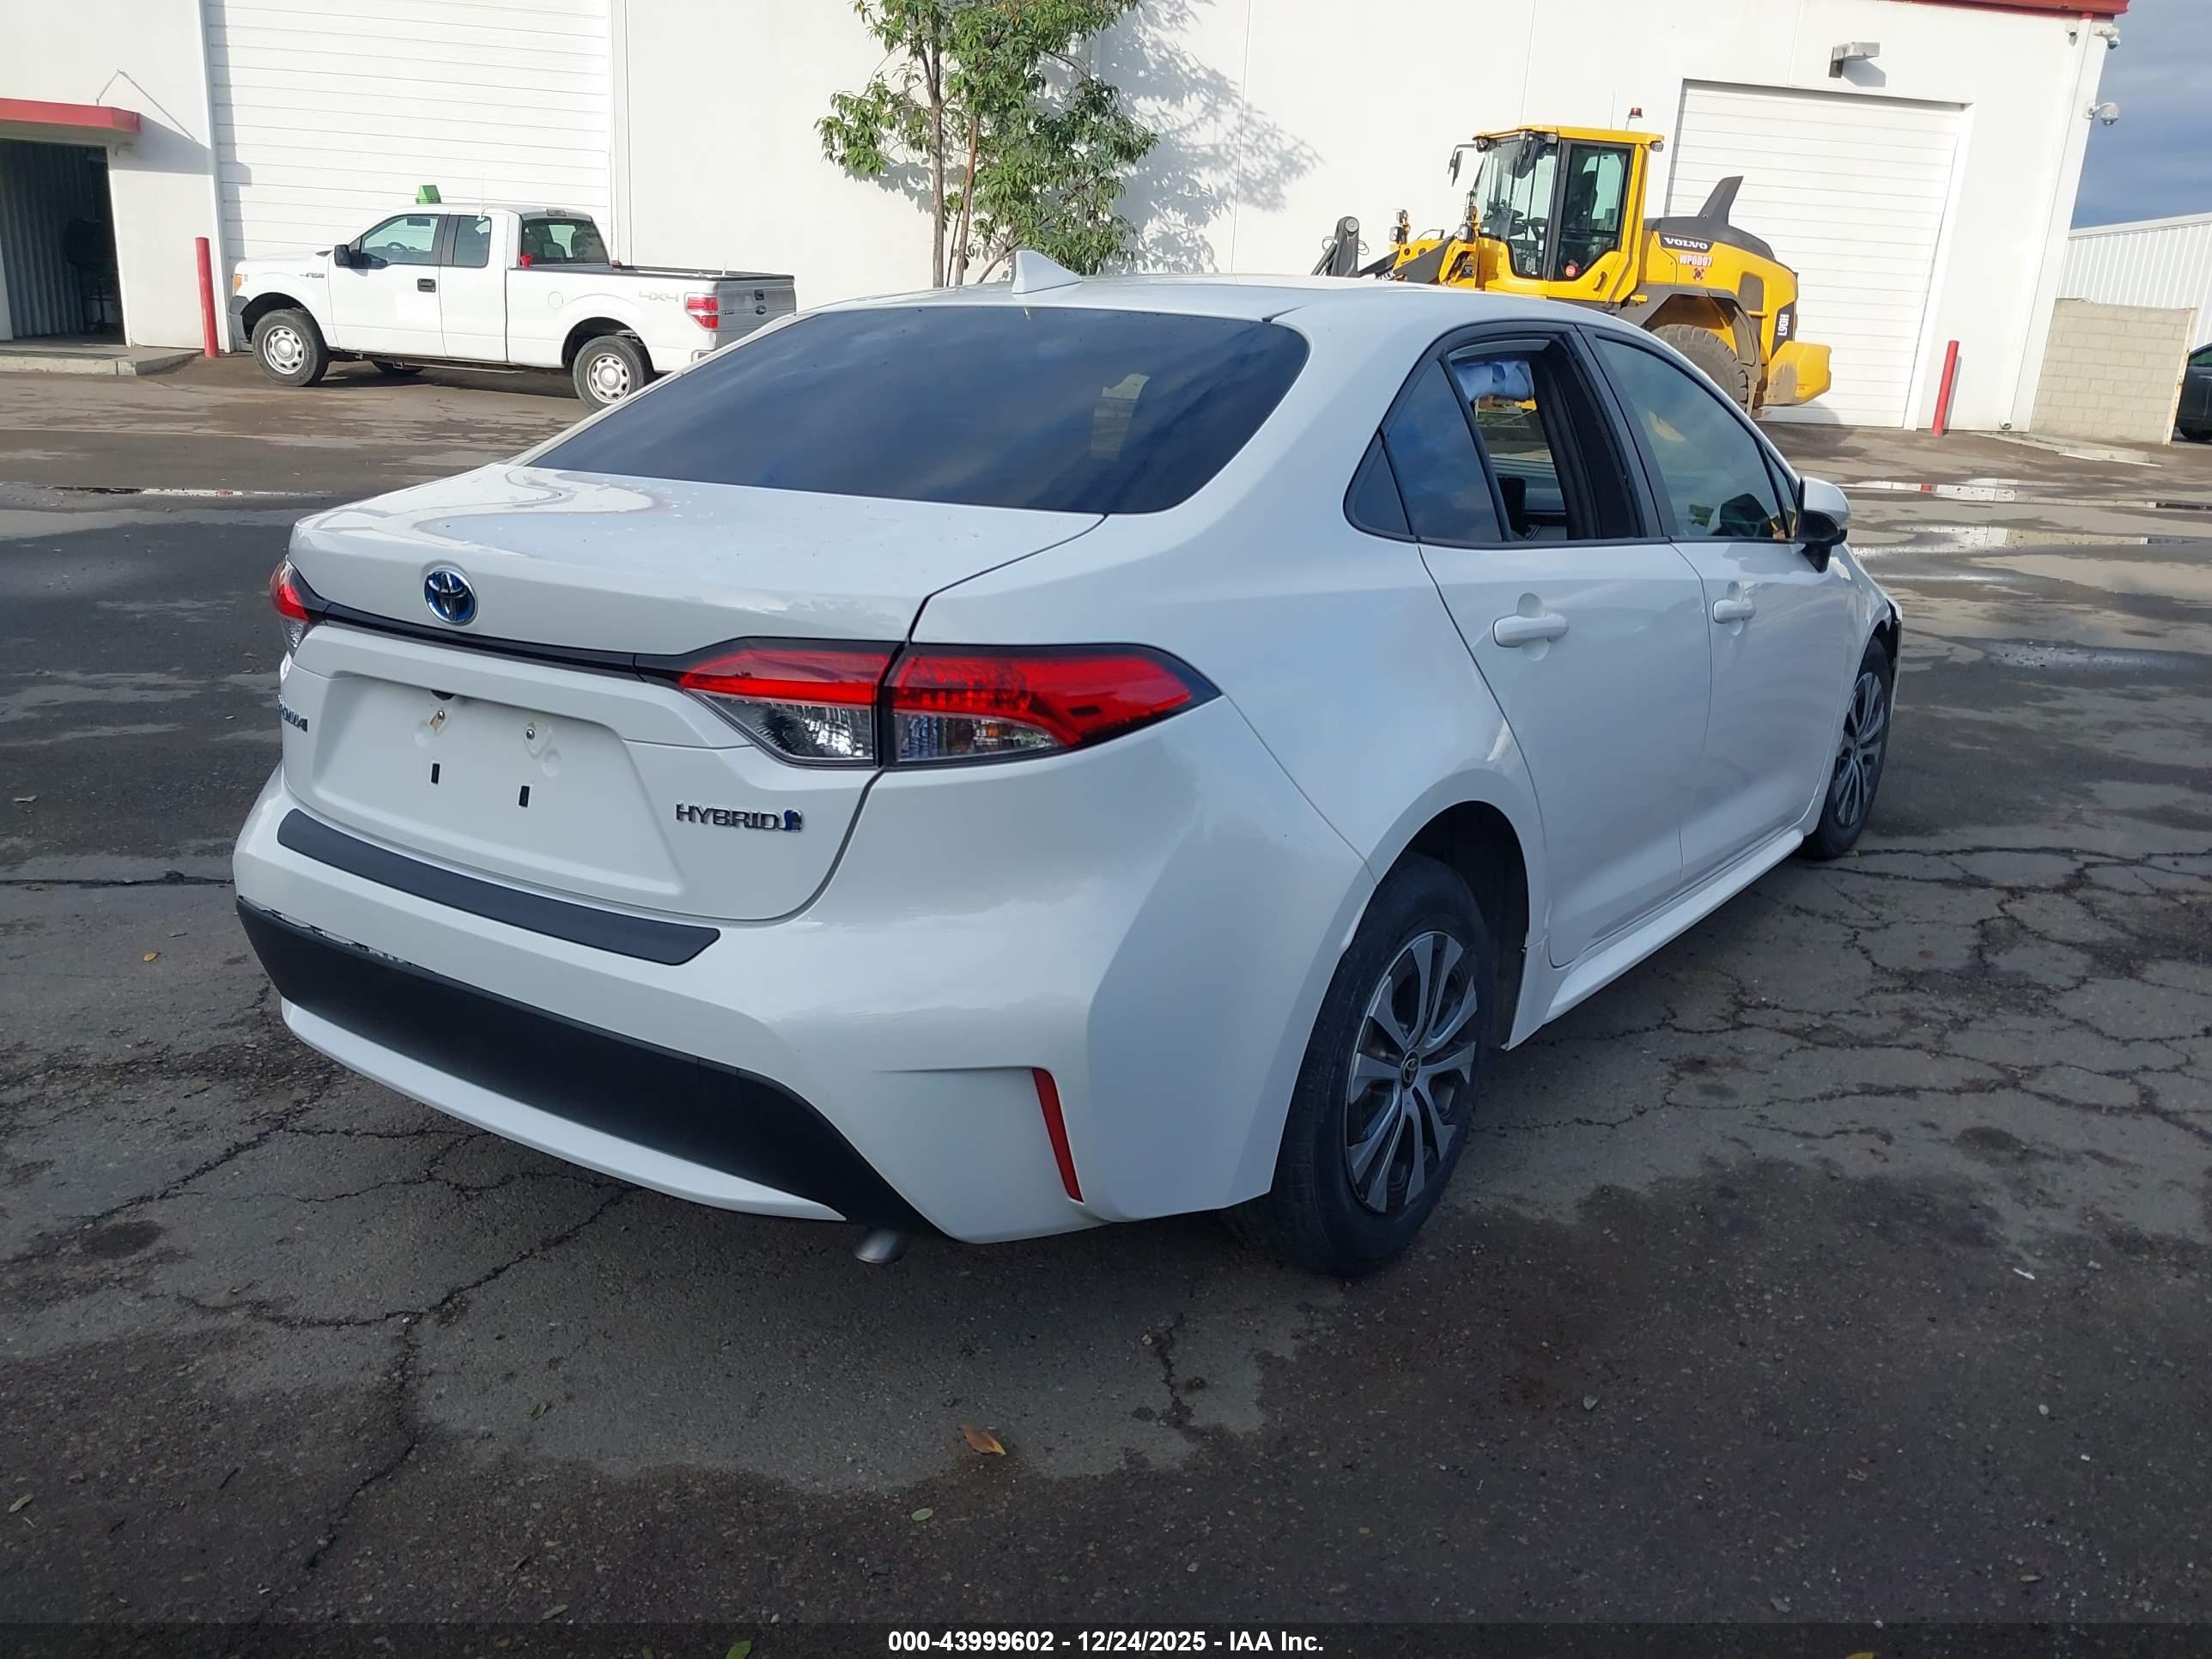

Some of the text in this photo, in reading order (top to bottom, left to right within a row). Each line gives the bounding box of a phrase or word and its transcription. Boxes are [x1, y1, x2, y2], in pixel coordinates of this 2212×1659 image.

[1662, 236, 1708, 250] VOLVO
[1777, 313, 1790, 337] L90H
[675, 802, 780, 831] HYBRID
